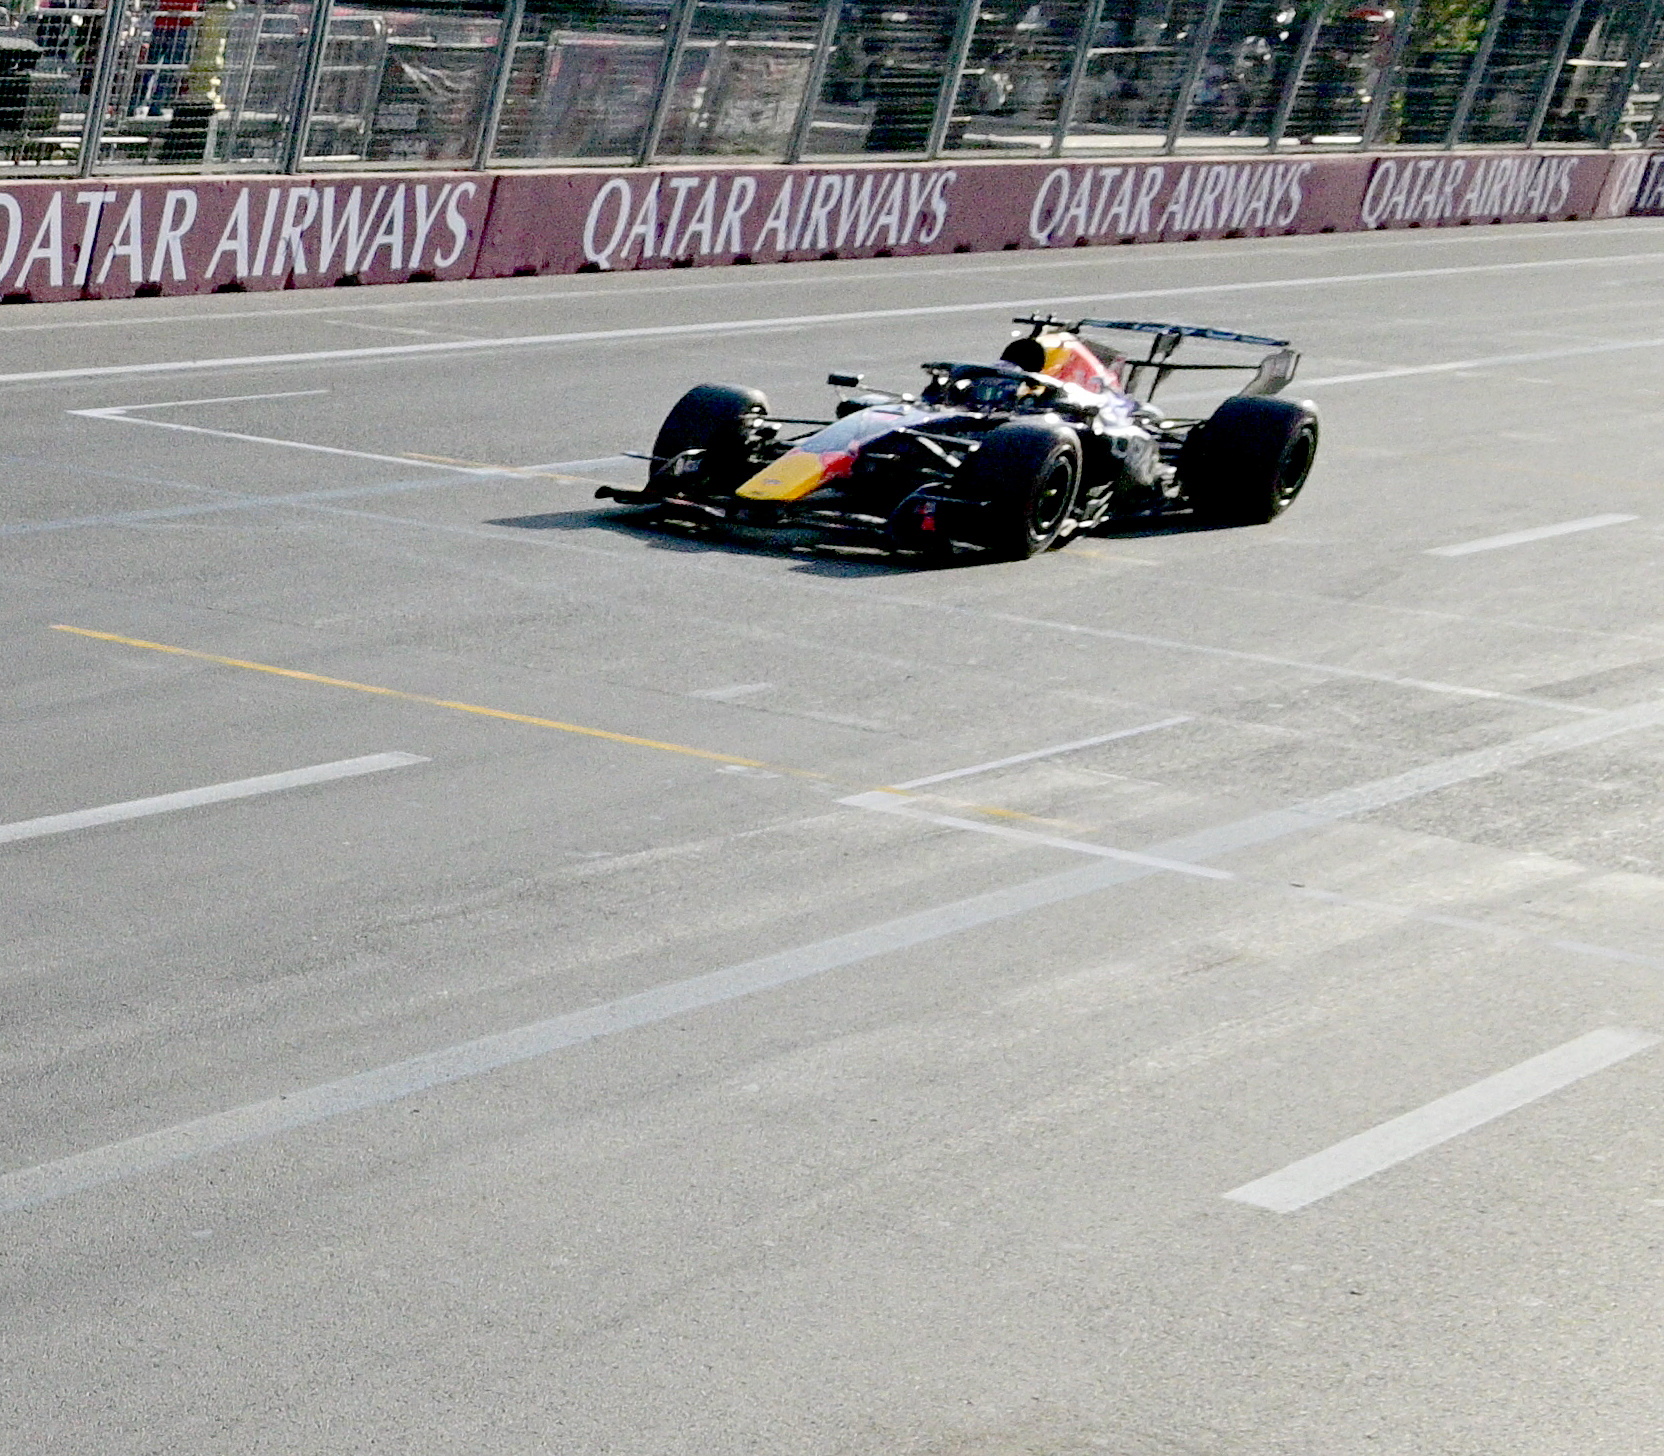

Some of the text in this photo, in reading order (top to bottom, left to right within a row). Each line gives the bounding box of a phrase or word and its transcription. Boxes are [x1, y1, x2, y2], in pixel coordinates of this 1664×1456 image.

[206, 181, 477, 279] AIRWAYS
[583, 169, 957, 270] QATAR AIRWAYS
[1029, 162, 1311, 245] QATAR AIRWAYS
[1361, 156, 1578, 229] QATAR AIRWAYS
